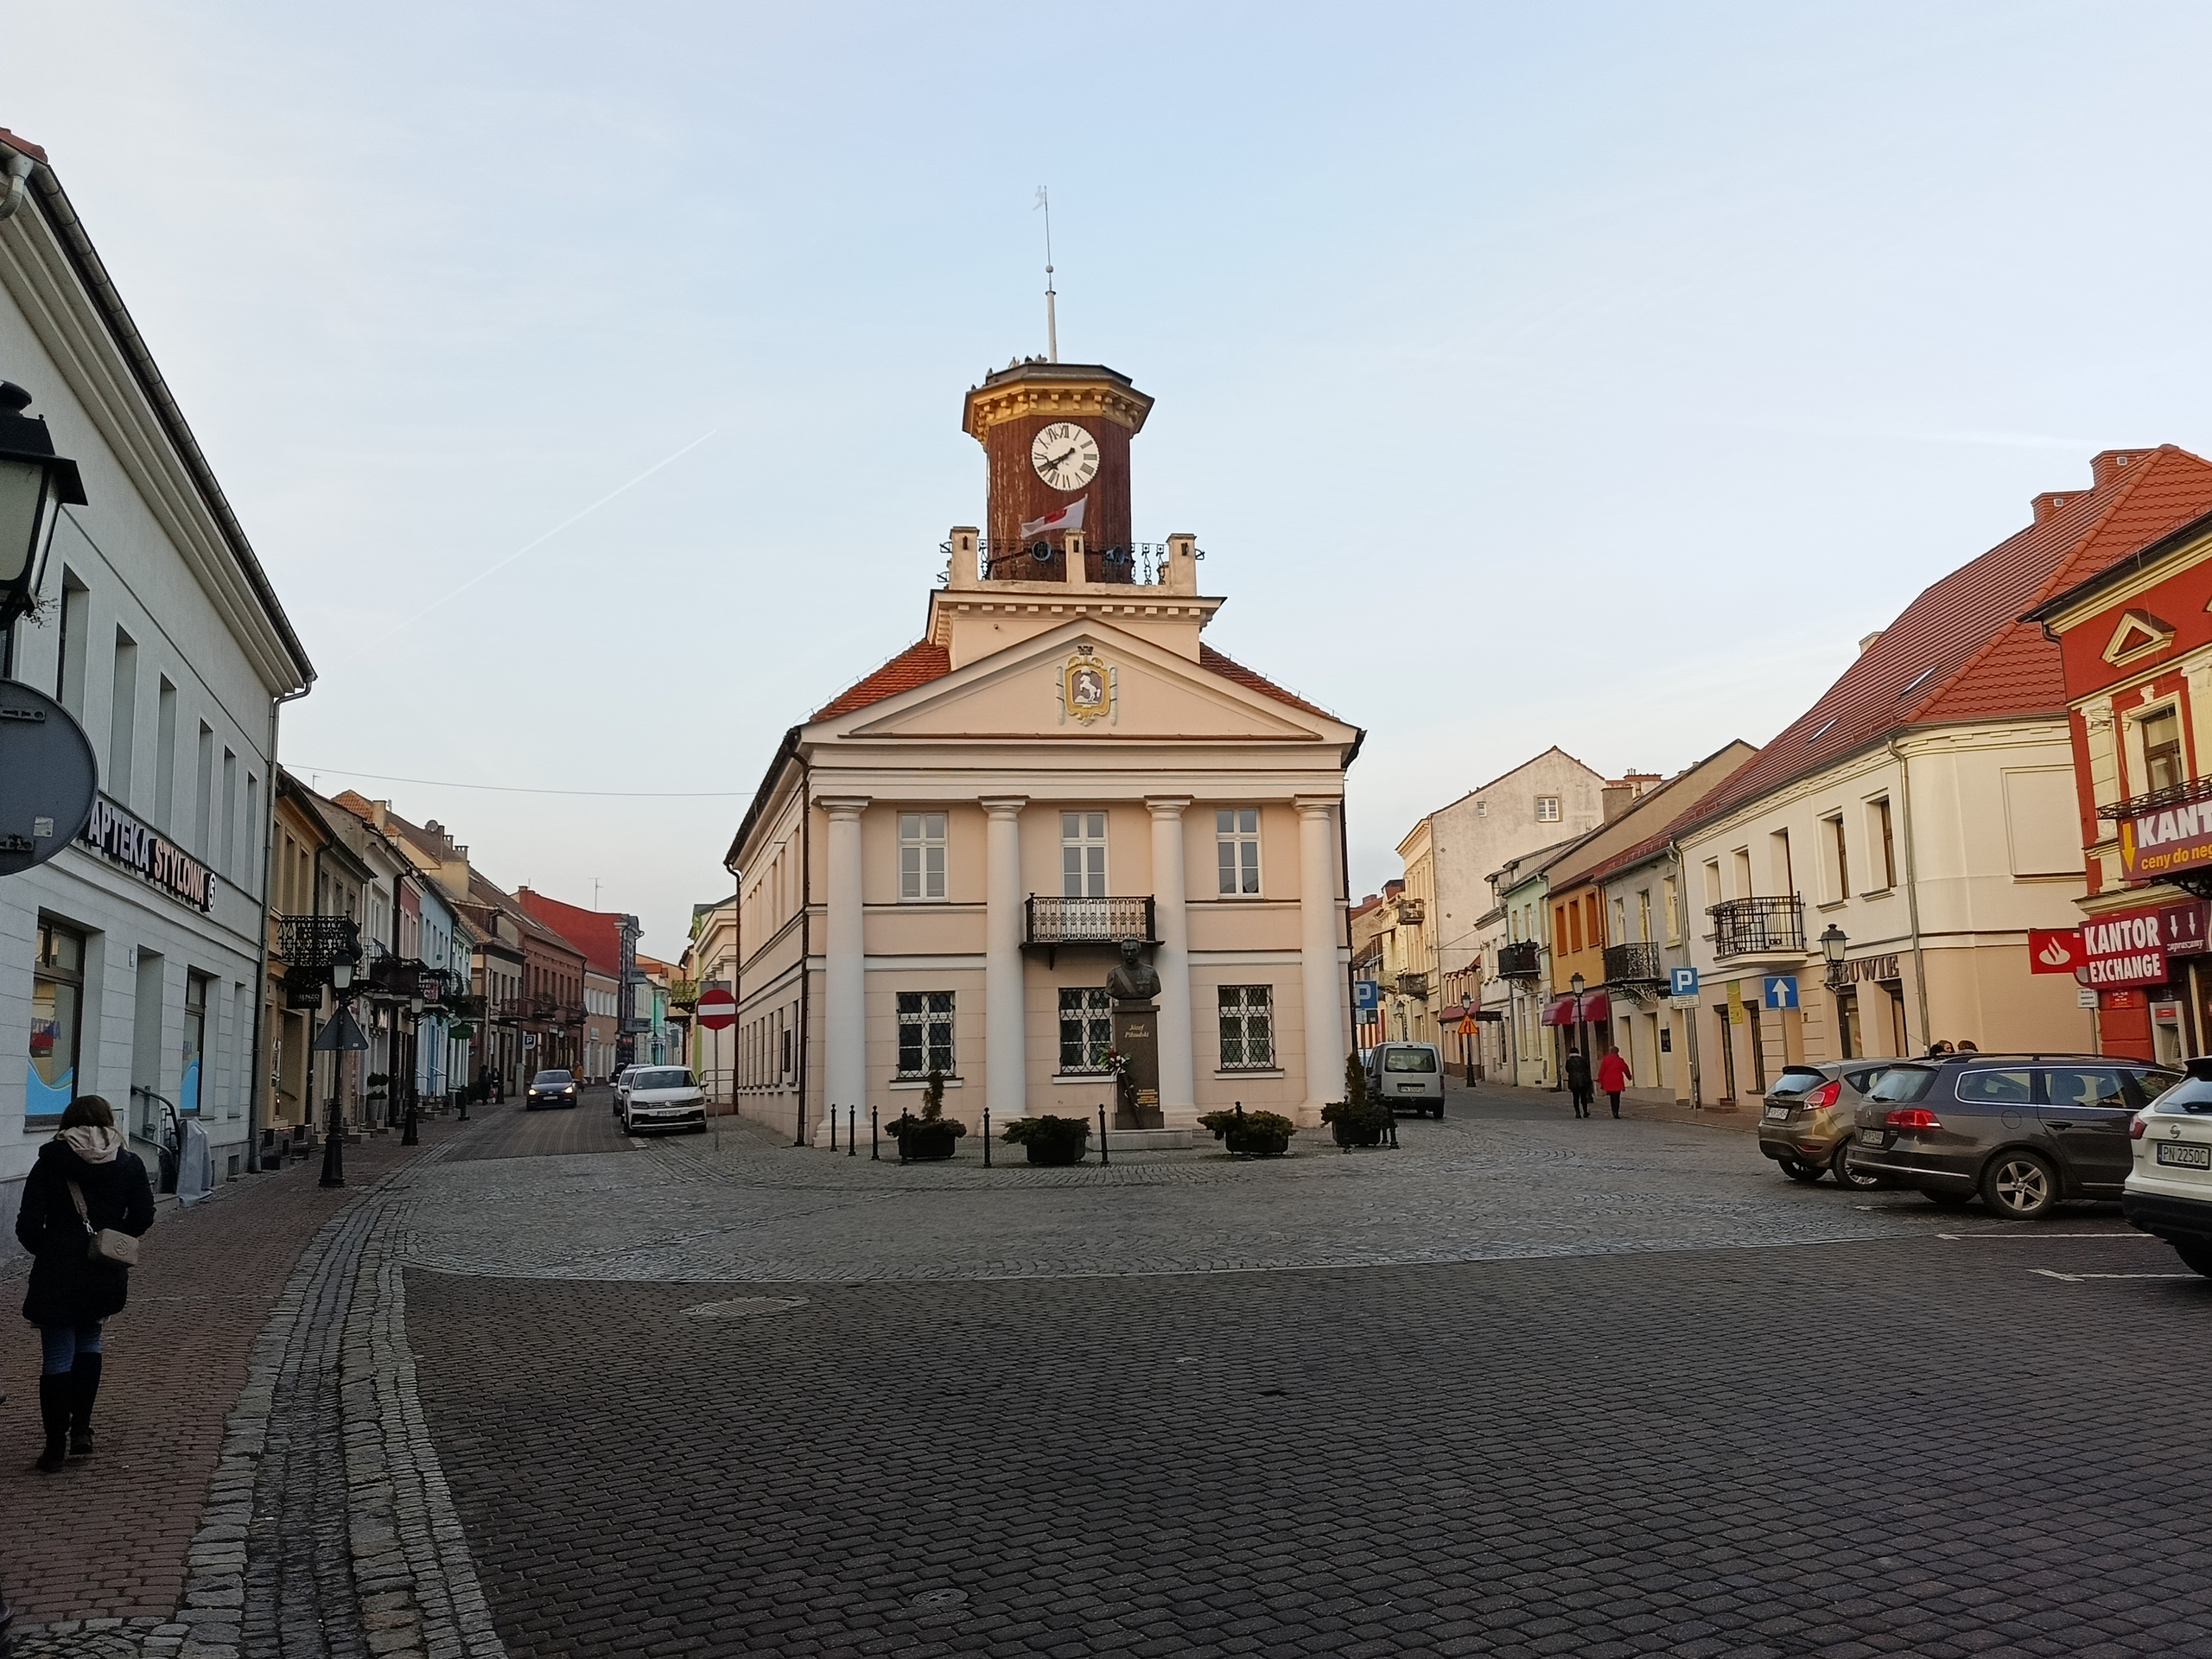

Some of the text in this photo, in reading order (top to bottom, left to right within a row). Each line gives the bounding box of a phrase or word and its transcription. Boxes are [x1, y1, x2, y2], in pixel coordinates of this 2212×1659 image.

[87, 798, 149, 873] APTEKA
[154, 838, 204, 906] STYLOWA
[2141, 854, 2171, 870] ceny
[2173, 848, 2189, 863] do
[2084, 916, 2161, 956] KANTOR
[1839, 955, 1899, 983] BUWIE
[2089, 952, 2162, 983] EXCHANGE
[1677, 970, 1692, 991] P
[31, 1017, 61, 1039] PTEKA
[2164, 1147, 2175, 1161] PN
